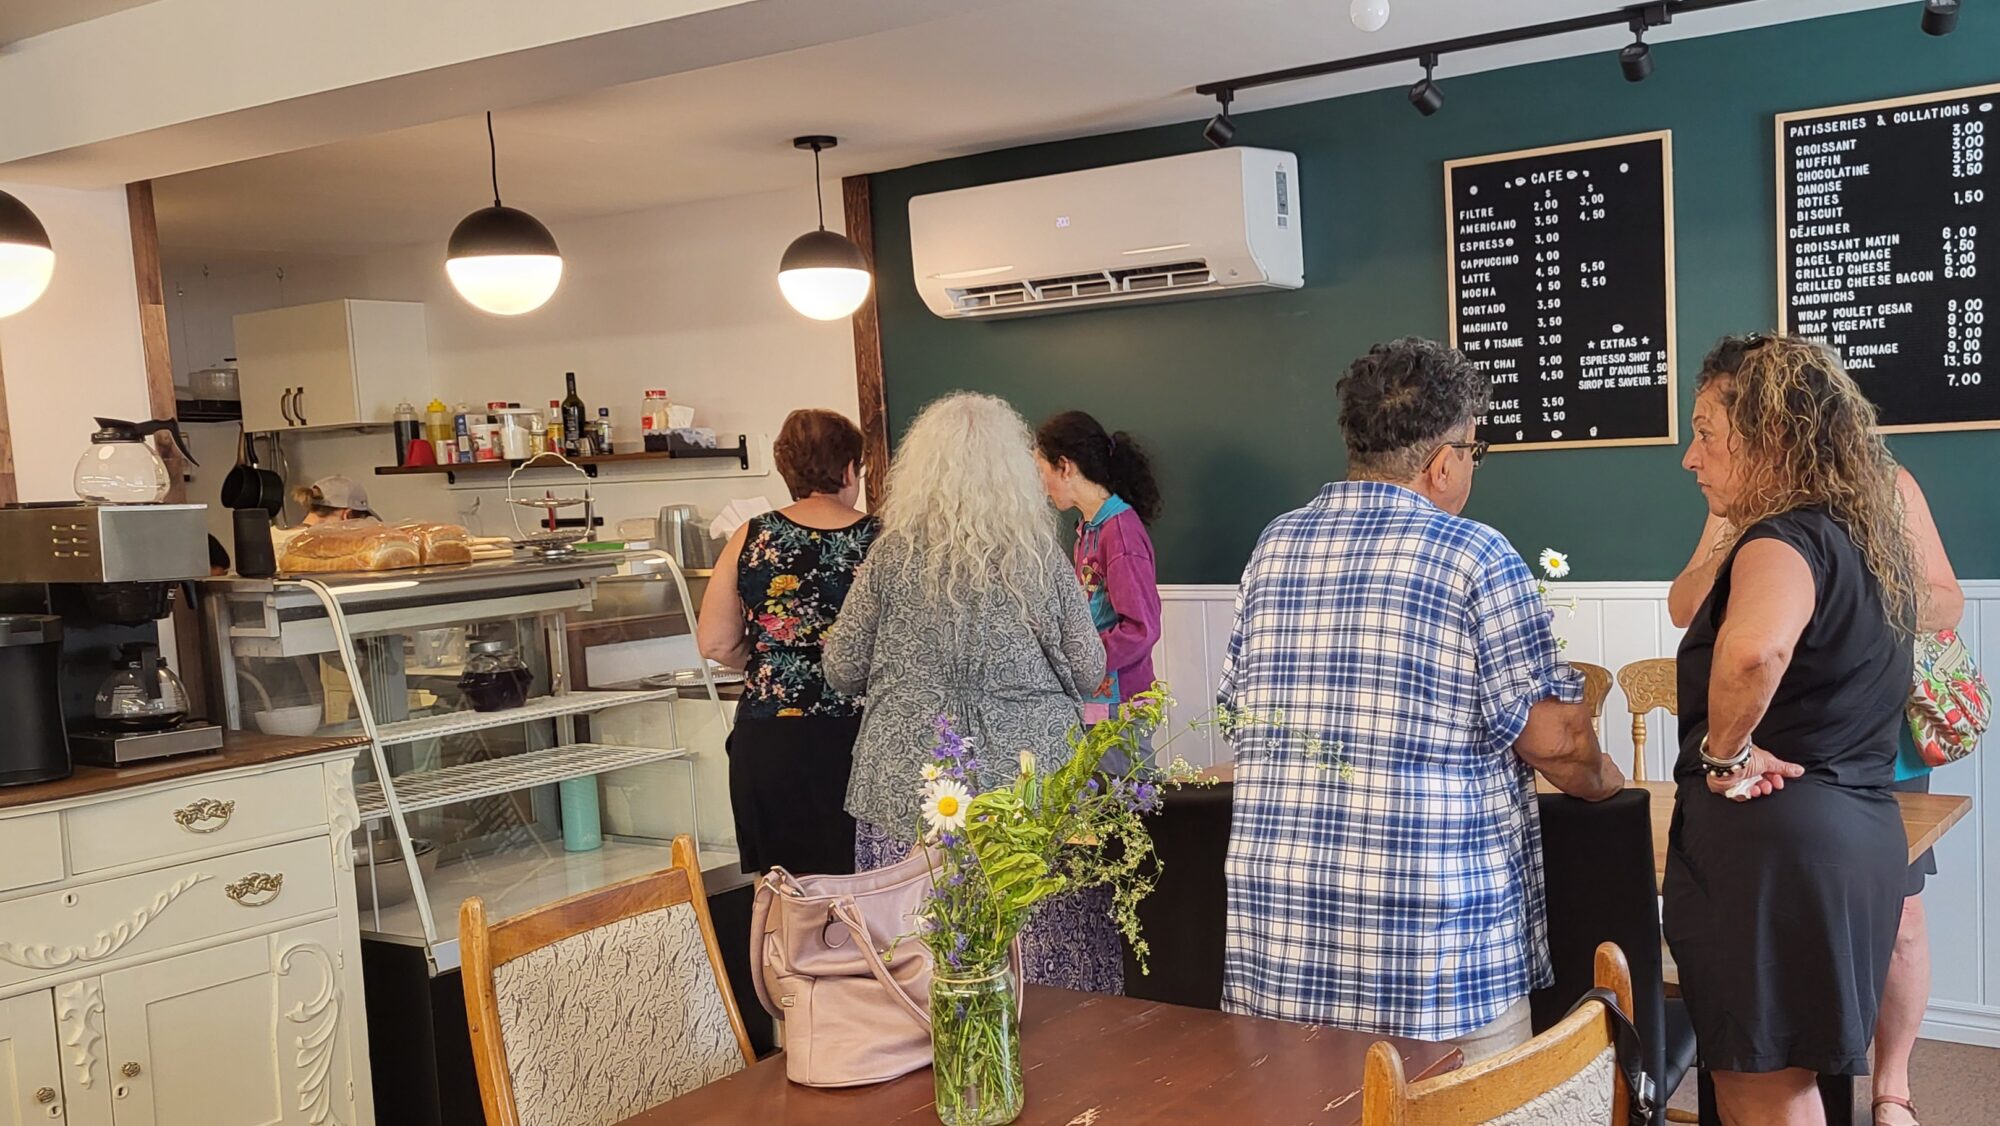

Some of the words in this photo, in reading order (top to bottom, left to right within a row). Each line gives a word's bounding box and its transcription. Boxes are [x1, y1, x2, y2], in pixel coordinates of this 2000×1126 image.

[1790, 117, 1866, 137] PATISSERIES
[1877, 115, 1886, 126] &
[1893, 103, 1969, 124] COLLATIONS
[1953, 121, 1983, 136] 3.00
[1796, 139, 1857, 156] CROISSANT
[1796, 154, 1841, 169] MUFFIN
[1531, 170, 1562, 184] CAFE
[1796, 164, 1869, 182] CHOCOLATINE
[1797, 181, 1842, 195] DANOISE
[1797, 194, 1839, 208] ROTIES
[1460, 207, 1493, 220] FILTRE
[1797, 207, 1843, 221] BISCUIT
[1460, 219, 1516, 234] AMERICANO
[1943, 226, 1976, 239] 6.00
[1796, 238, 1860, 253] CROISSANT
[1866, 234, 1899, 247] MATIN
[1943, 239, 1974, 253] 4.50
[1461, 255, 1518, 269] CAPPUCCINO
[1796, 254, 1832, 267] BAGEL
[1838, 248, 1891, 263] FROMAGE
[1945, 252, 1975, 266] 5.00
[1796, 265, 1843, 280] GRILLED
[1848, 261, 1890, 276] CHEESE
[1463, 273, 1490, 284] LATTE
[1796, 278, 1842, 292] GRILLED
[1847, 275, 1891, 288] CHEESE
[1896, 271, 1933, 284] BACON
[1462, 287, 1496, 298] MOCHA
[1792, 291, 1855, 305] SANDWICHS
[1463, 304, 1505, 315] CORTADO
[1798, 310, 1827, 321] WRAP
[1833, 306, 1873, 319] POULET
[1878, 303, 1912, 315] CESAR
[1948, 298, 1982, 313] 9.00
[1798, 323, 1827, 334] WRAP
[1832, 320, 1859, 331] VEGE
[1859, 318, 1885, 329] PATE
[1948, 312, 1983, 326] 9.00
[1463, 322, 1508, 333] MACHIATO
[1948, 326, 1982, 340] 9.00
[1464, 341, 1480, 351] THE
[1494, 338, 1523, 348] TISANE
[1601, 338, 1637, 349] EXTRAS
[1834, 334, 1846, 344] MI
[1948, 339, 1980, 353] 9.00
[1849, 343, 1898, 356] FROMAGE
[1494, 359, 1515, 369] CHAI
[1580, 354, 1626, 366] ESPRESSO
[1629, 352, 1651, 362] SHOT
[1843, 358, 1875, 370] LOCAL
[1944, 352, 1982, 366] 13.50
[1583, 367, 1603, 377] LAIT
[1609, 364, 1649, 375] D'AVOINE
[1491, 373, 1518, 384] LATTE
[1579, 379, 1602, 389] SIROP
[1604, 379, 1615, 388] DE
[1618, 377, 1651, 387] SAVEUR
[1489, 399, 1519, 410] GLACE
[1494, 414, 1521, 424] GLACE
